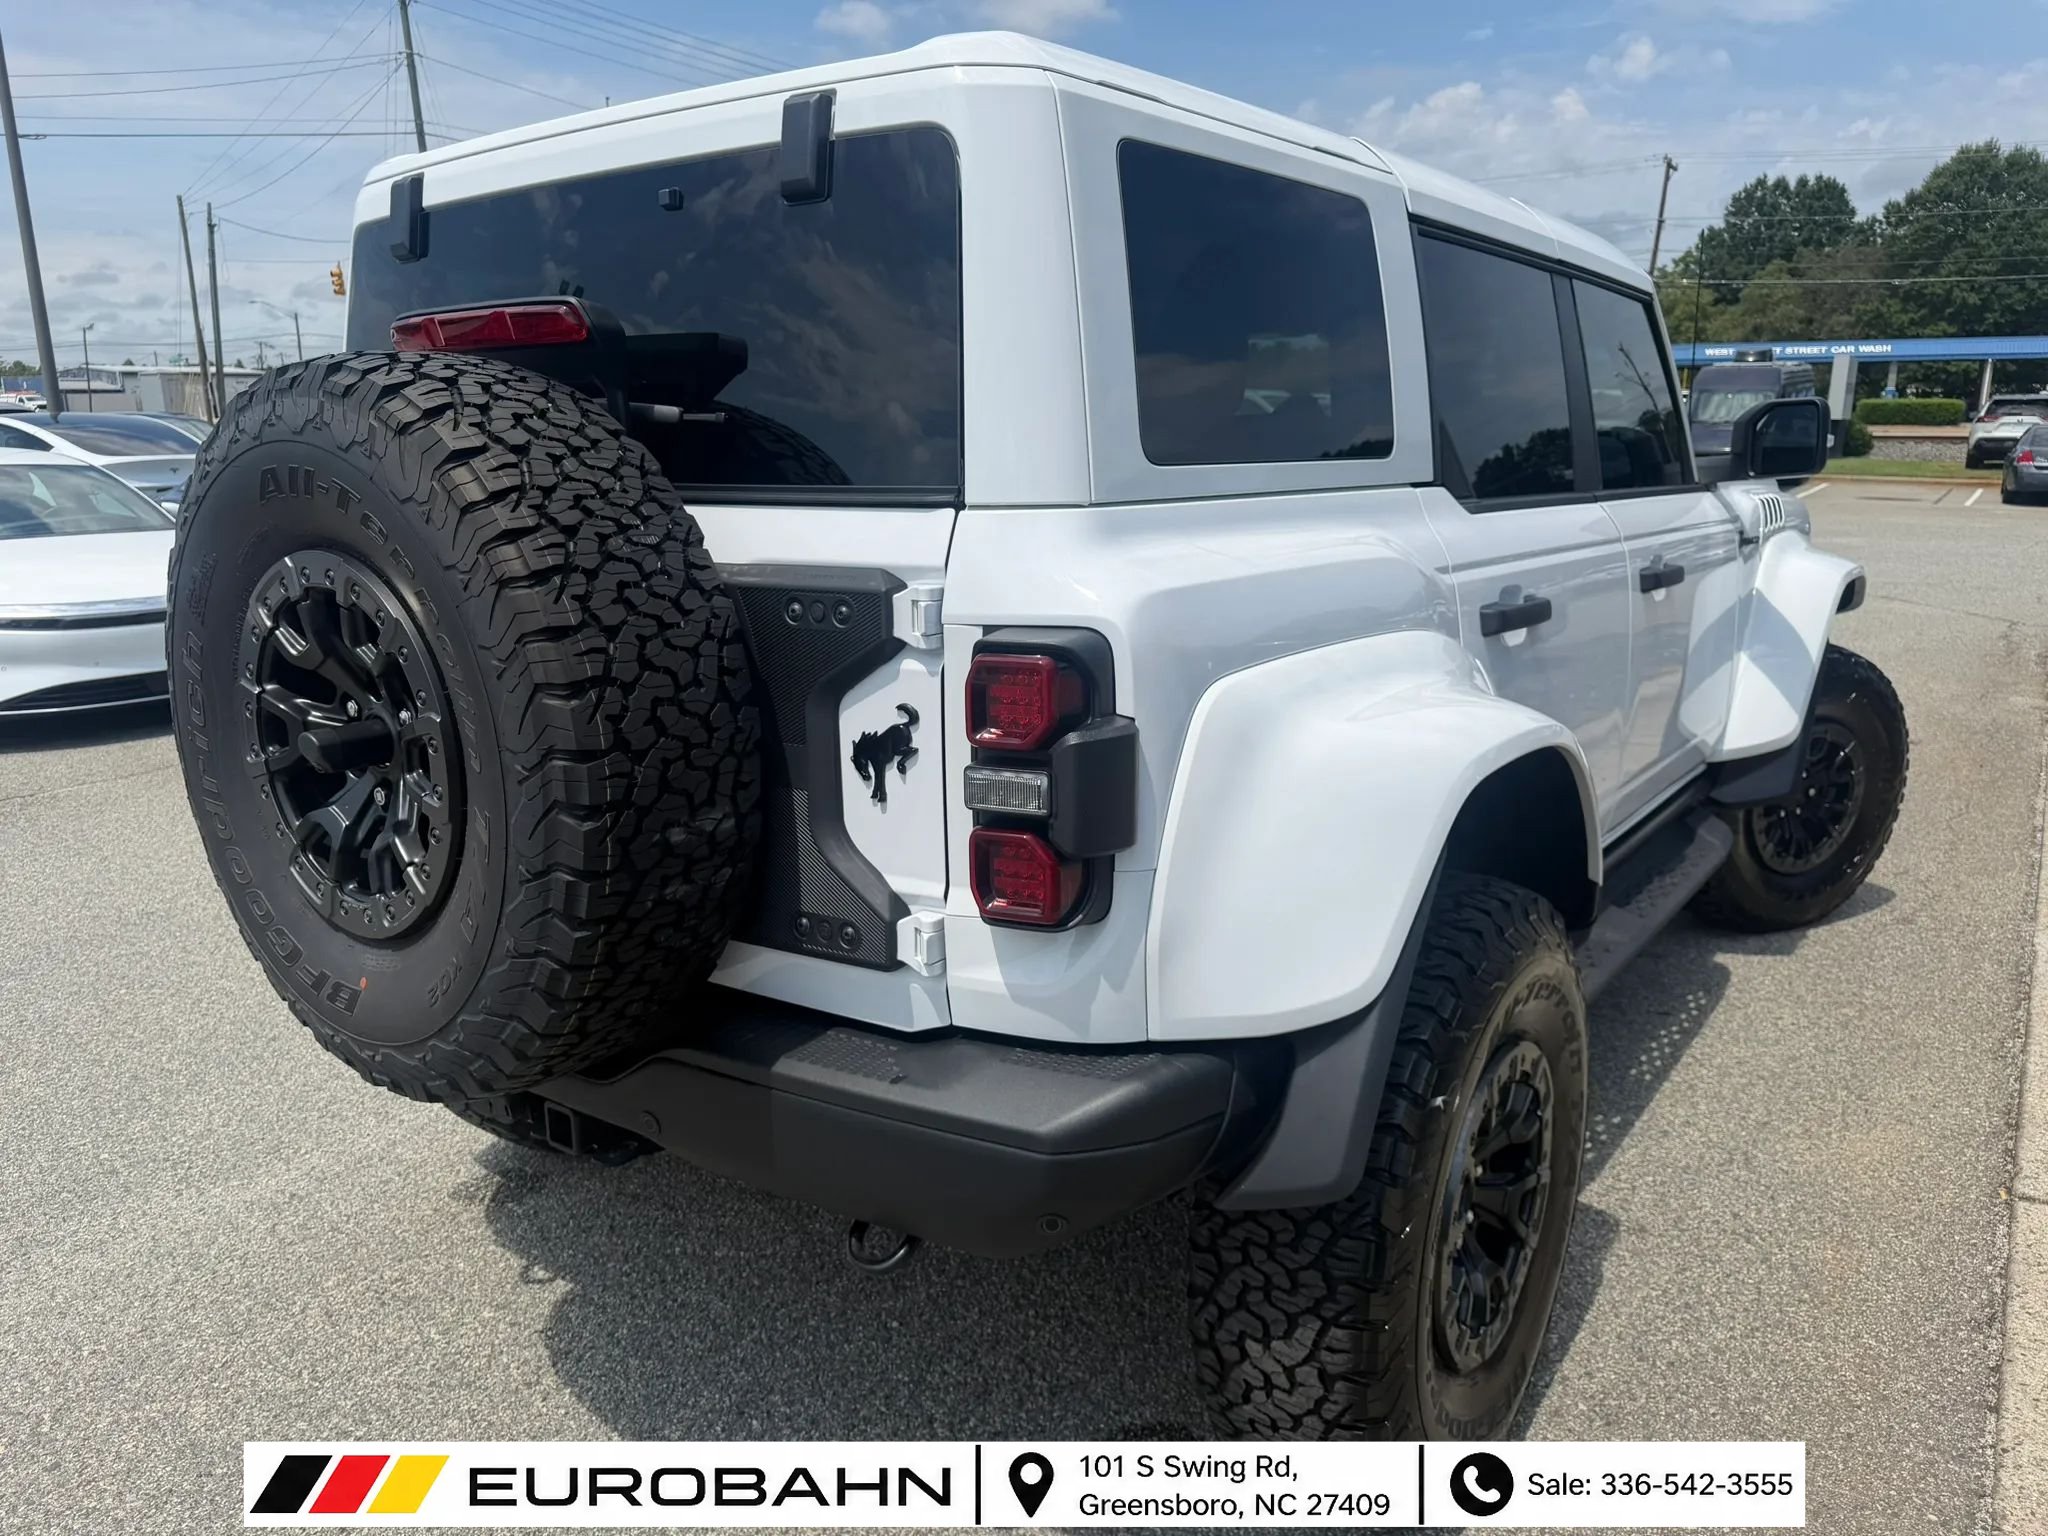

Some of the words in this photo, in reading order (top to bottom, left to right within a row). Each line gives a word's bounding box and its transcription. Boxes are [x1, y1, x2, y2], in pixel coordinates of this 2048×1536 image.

[1705, 348, 1735, 356] WEST
[1784, 346, 1828, 355] STREET
[1831, 345, 1856, 354] CAR
[1858, 344, 1892, 353] WASH
[259, 463, 482, 774] All-Terrain
